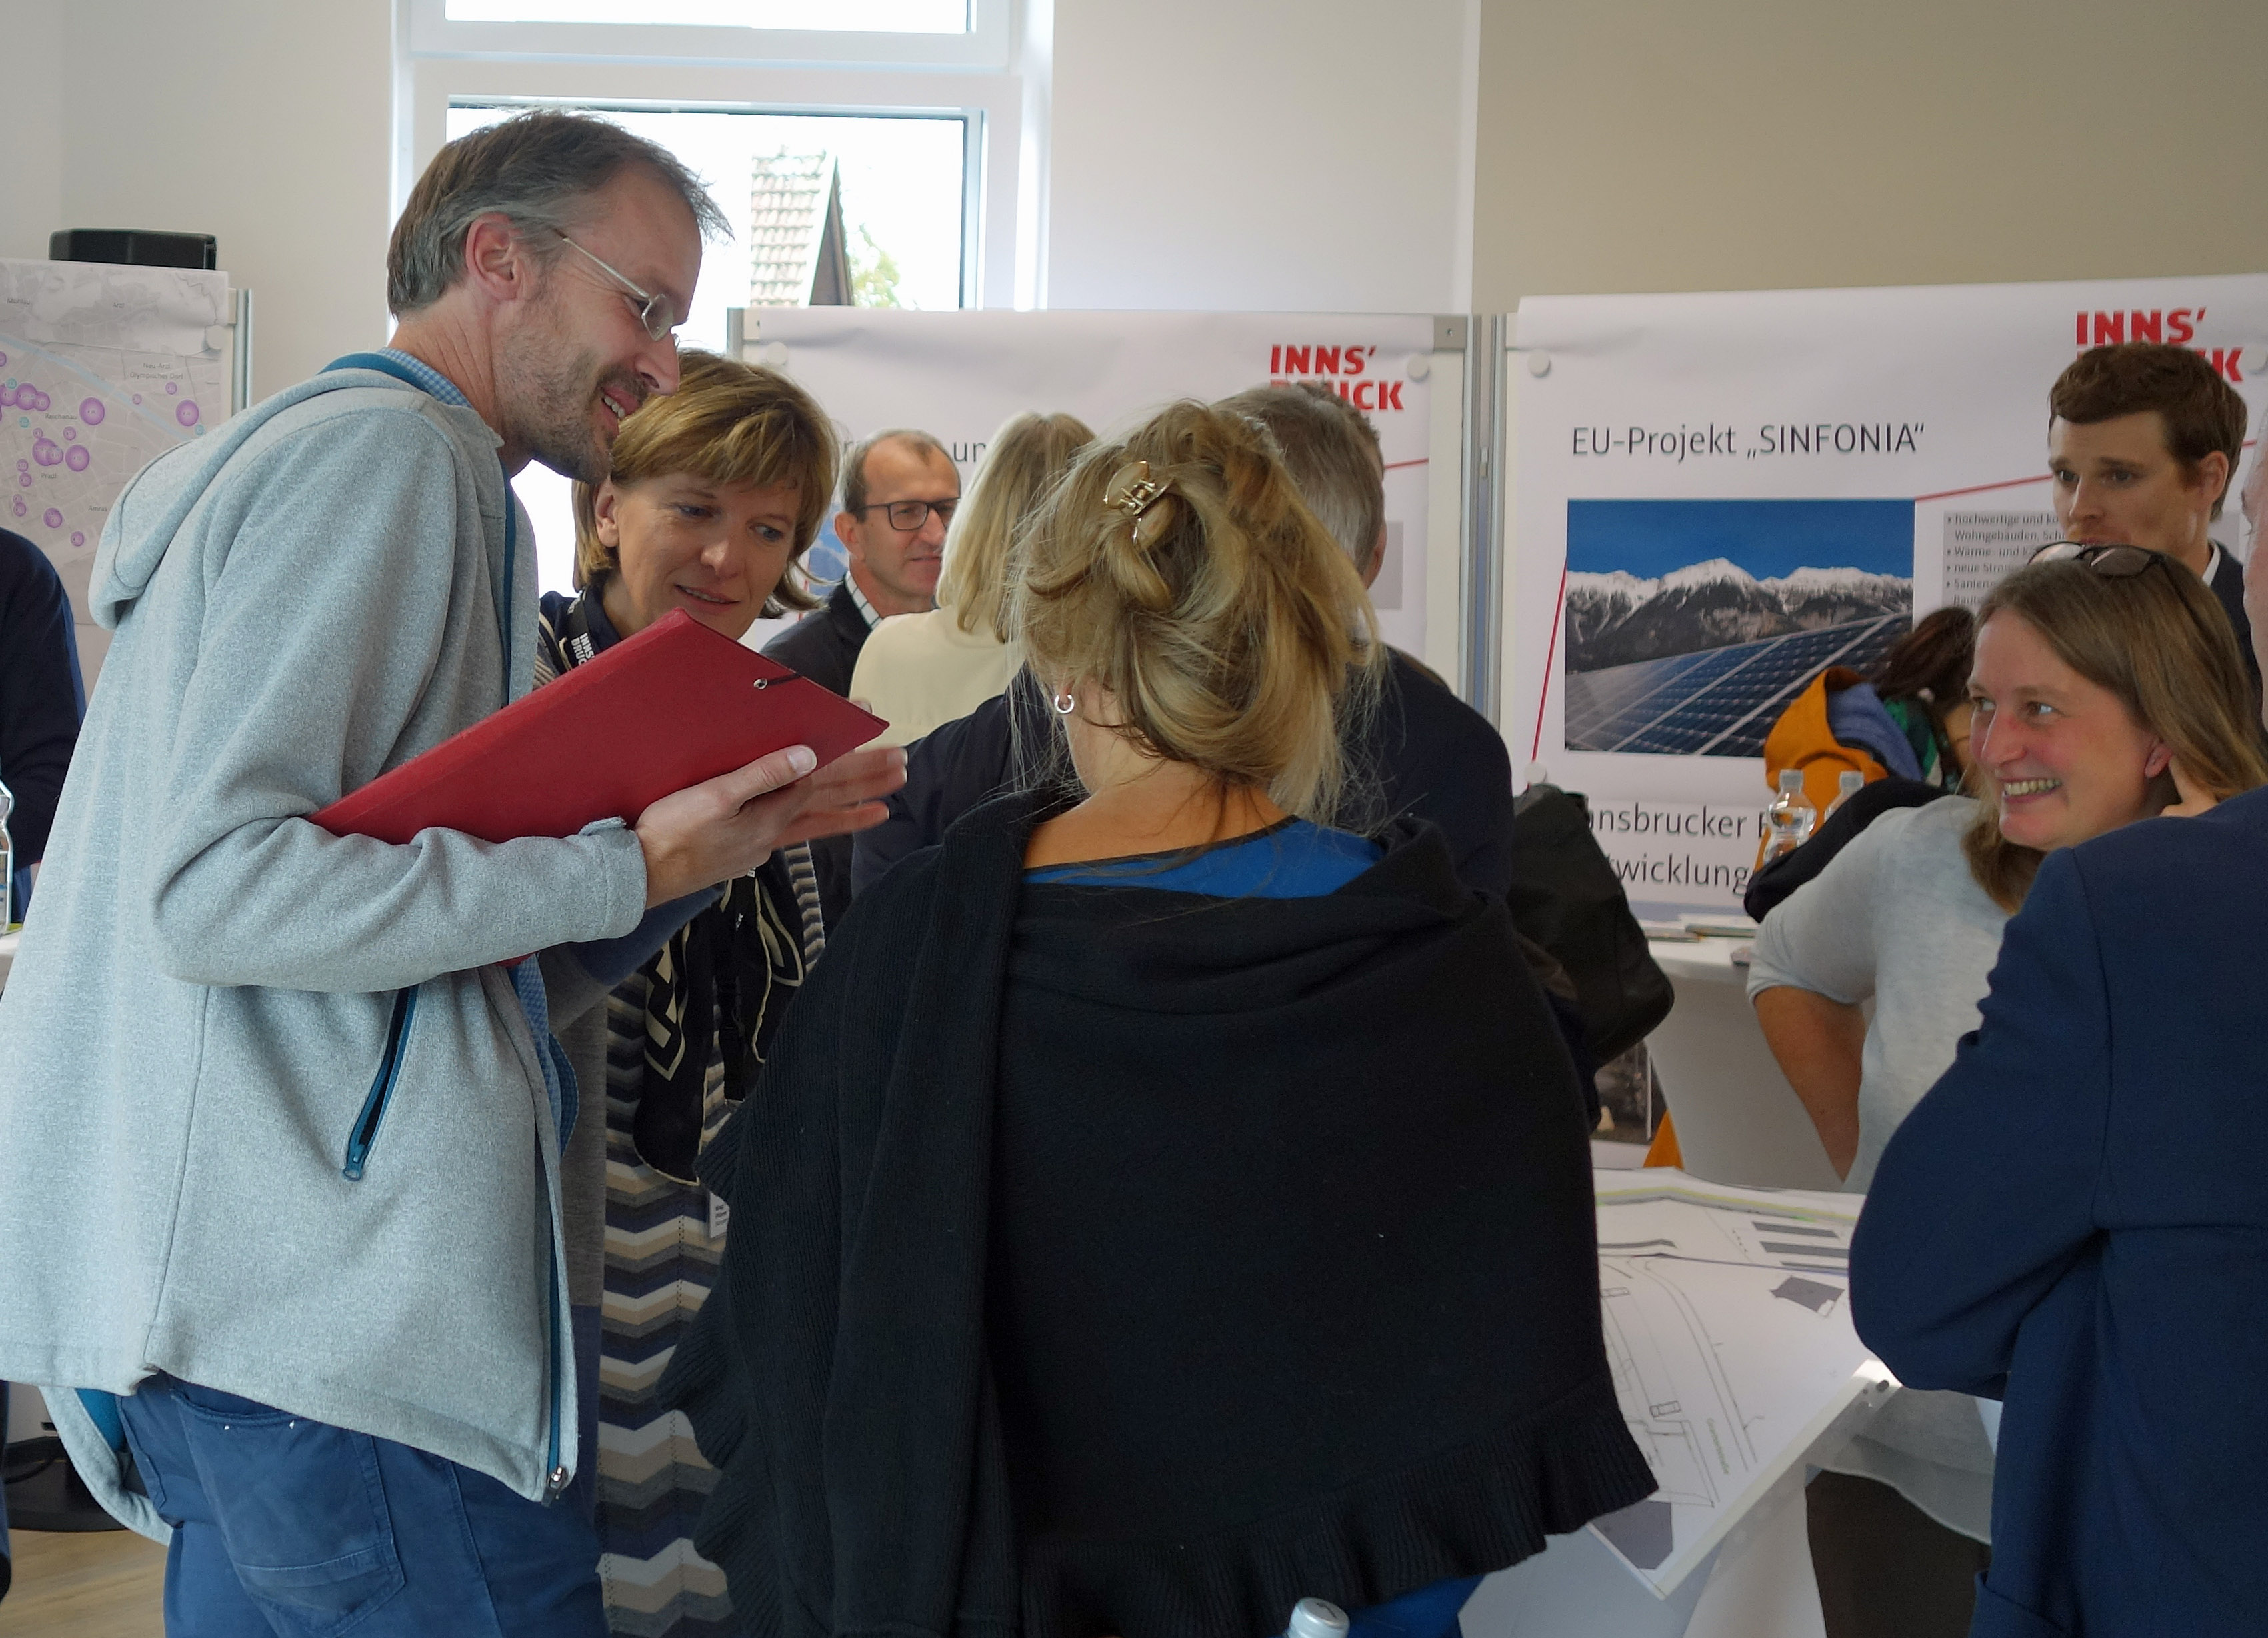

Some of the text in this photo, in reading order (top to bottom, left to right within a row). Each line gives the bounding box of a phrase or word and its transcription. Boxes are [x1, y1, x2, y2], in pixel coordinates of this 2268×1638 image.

[1573, 422, 1737, 464] EU-Projekt
[1955, 514, 2019, 526] hochwertige
[2023, 514, 2043, 525] und
[571, 637, 587, 666] BRUC
[1588, 802, 1747, 838] nsbrucker
